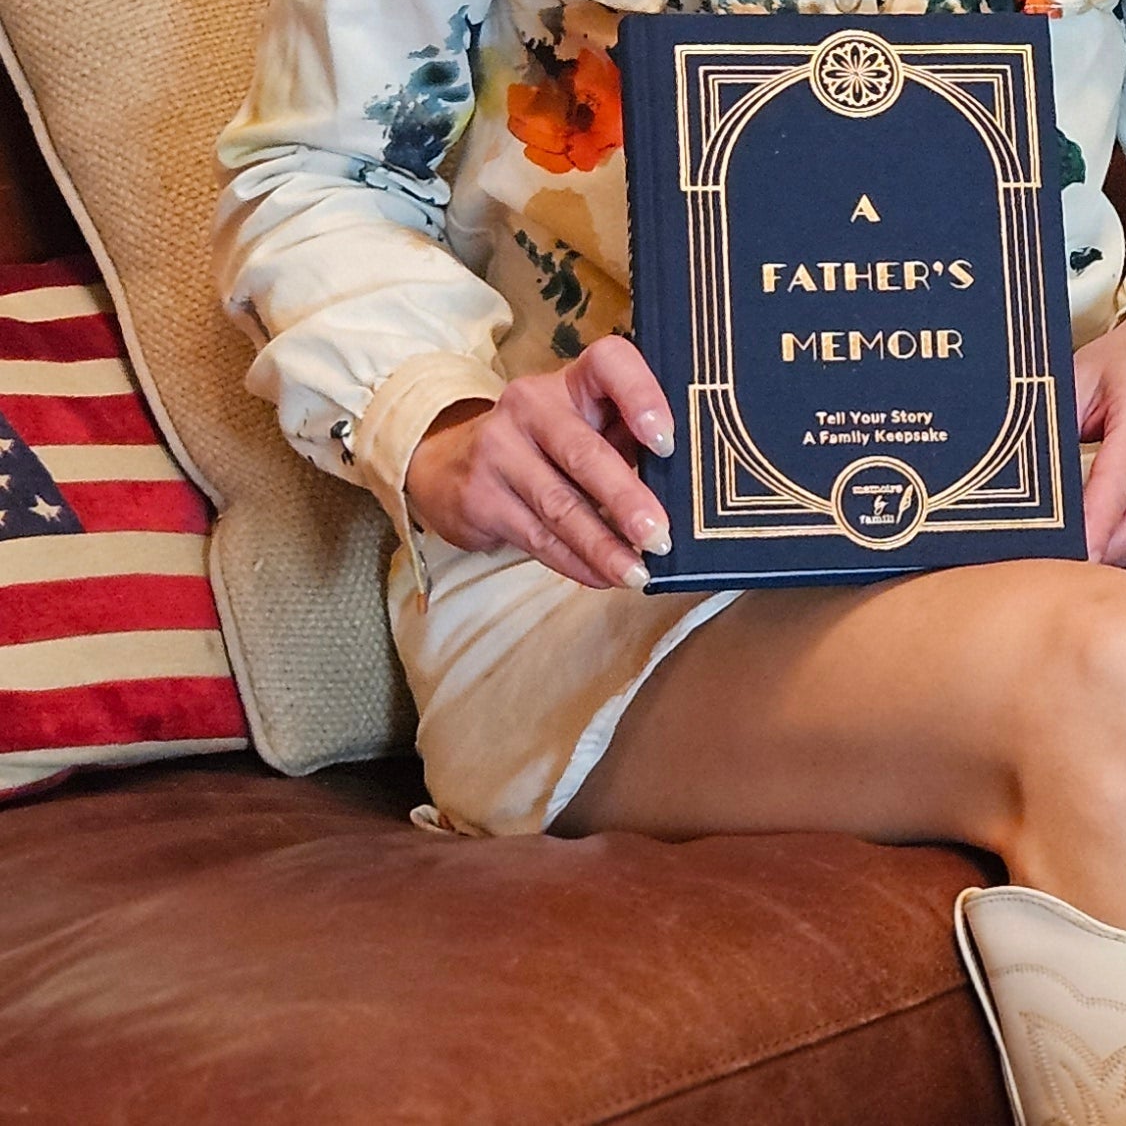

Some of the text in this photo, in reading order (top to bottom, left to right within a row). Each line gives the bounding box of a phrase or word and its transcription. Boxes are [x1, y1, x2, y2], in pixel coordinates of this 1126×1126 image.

[850, 194, 881, 223] A
[761, 259, 975, 293] FATHER'S
[781, 329, 964, 362] MEMOIR
[815, 409, 933, 426] Tell Your Story
[802, 427, 948, 446] A Family Keepsake
